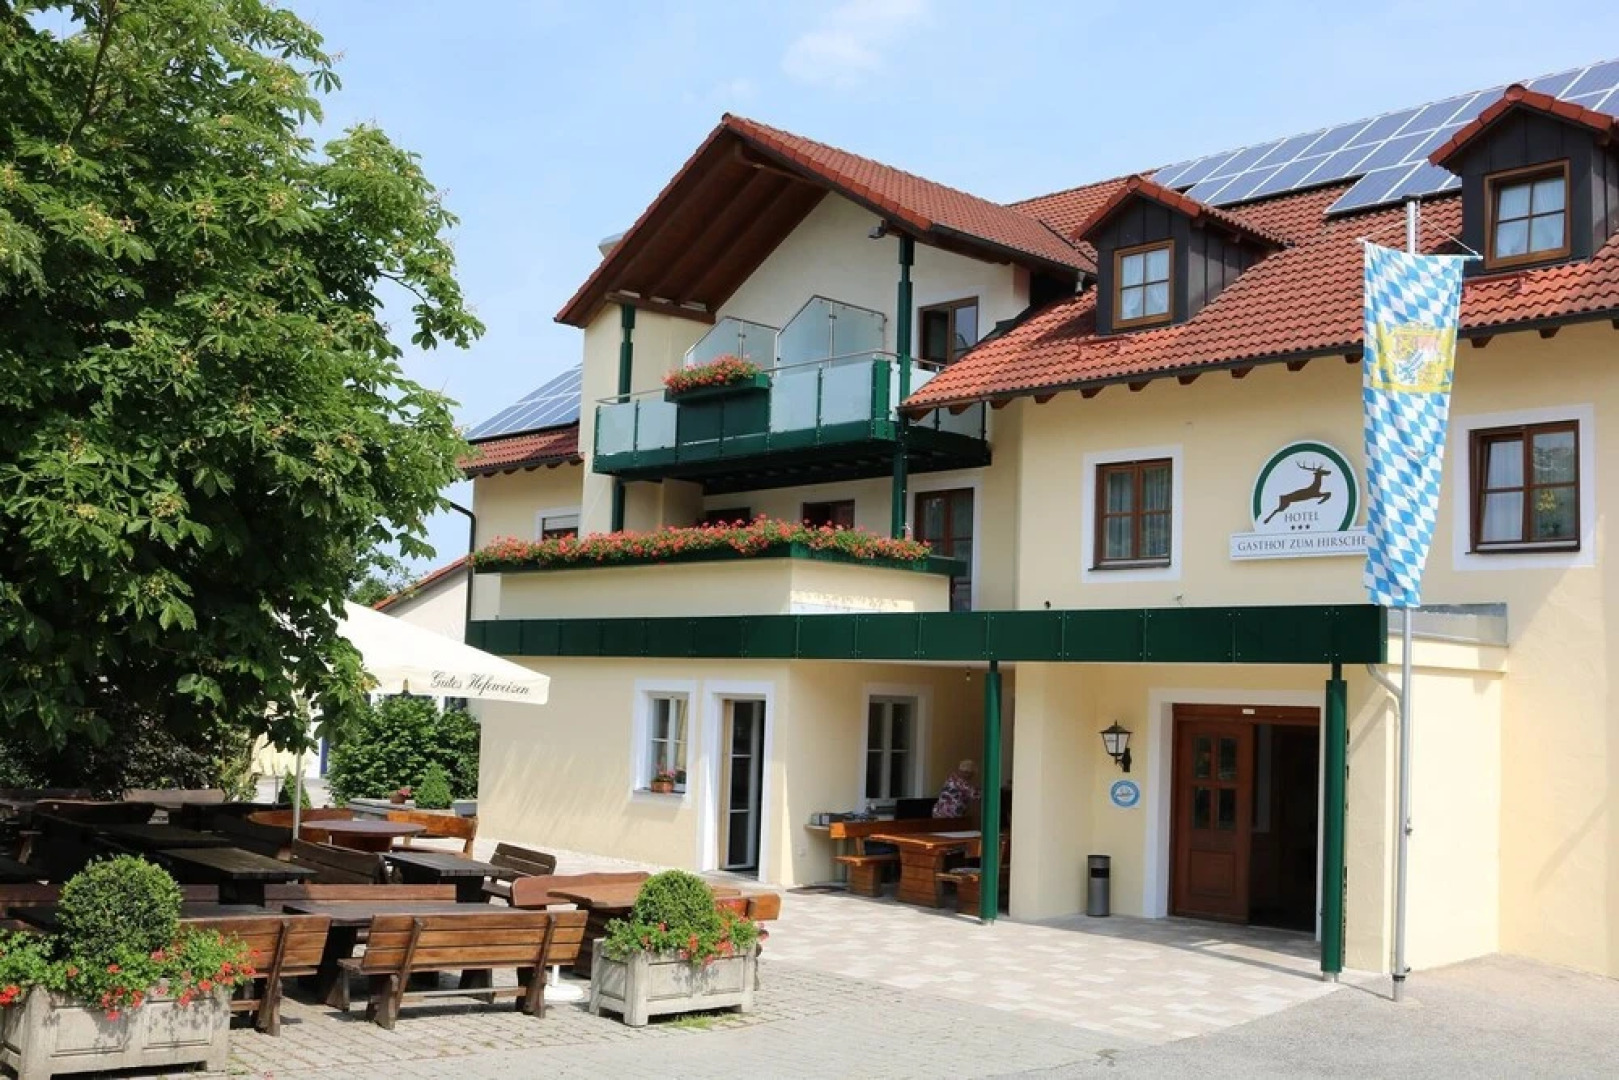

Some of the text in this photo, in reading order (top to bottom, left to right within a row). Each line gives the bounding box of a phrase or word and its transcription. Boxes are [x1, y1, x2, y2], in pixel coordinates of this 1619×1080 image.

[1285, 511, 1319, 522] HOTEL
[1237, 535, 1367, 551] GASTHOF ZUM HIRSCHE
[431, 670, 462, 688] Gutes
